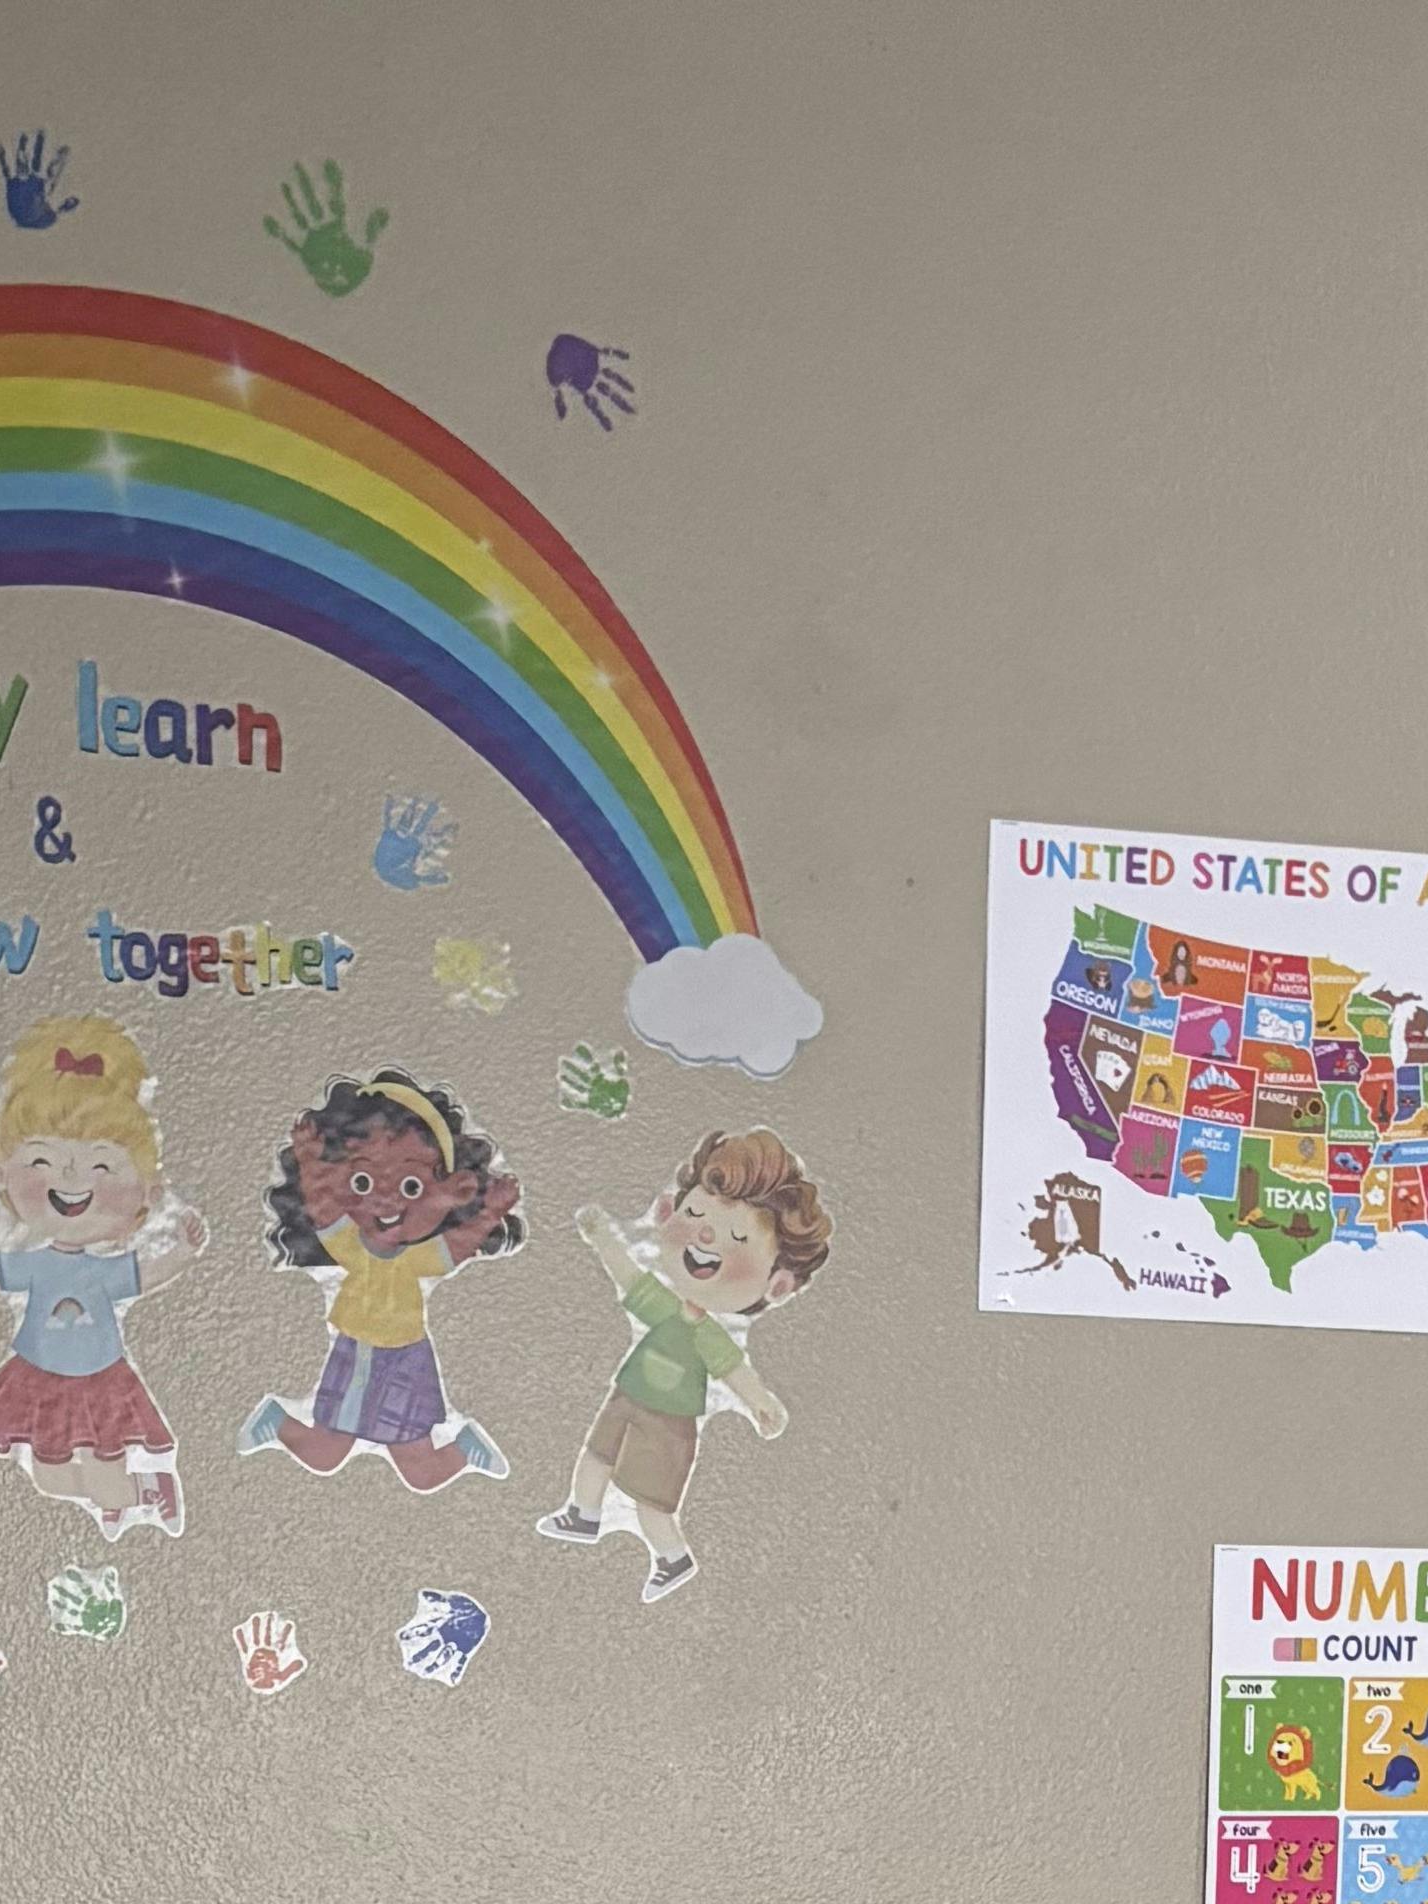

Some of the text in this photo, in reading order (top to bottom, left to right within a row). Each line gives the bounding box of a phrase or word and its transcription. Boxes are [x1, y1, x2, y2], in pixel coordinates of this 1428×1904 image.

[76, 659, 282, 773] learn
[33, 795, 76, 865] &
[1019, 839, 1175, 886] UNITED
[1191, 855, 1330, 900] STATES
[1346, 866, 1401, 903] OF
[86, 909, 355, 997] together
[1196, 955, 1246, 973] MONTANA
[1056, 981, 1117, 1014] OREGON
[1139, 1015, 1173, 1030] IDAHO
[1180, 1005, 1223, 1022] WYOMING
[1089, 1024, 1137, 1054] NEVADA
[1263, 1073, 1313, 1084] NEBRASKA
[1258, 1087, 1298, 1106] KANSAS
[1129, 1110, 1179, 1129] ARIZONA
[1192, 1105, 1245, 1123] COLORADO
[1201, 1127, 1223, 1138] NEW
[1192, 1137, 1230, 1152] MEXICO
[1051, 1183, 1101, 1202] ALASKA
[1264, 1187, 1326, 1211] TEXAS
[1140, 1268, 1207, 1295] HAWAII
[1323, 1634, 1417, 1663] COUNT
[1239, 1683, 1262, 1695] one
[1366, 1684, 1391, 1698] two
[1245, 1704, 1255, 1756] 1
[1362, 1705, 1393, 1755] 2
[1232, 1823, 1260, 1838] four
[1360, 1822, 1386, 1837] five
[1230, 1844, 1260, 1894] 4
[1356, 1845, 1387, 1893] 5
